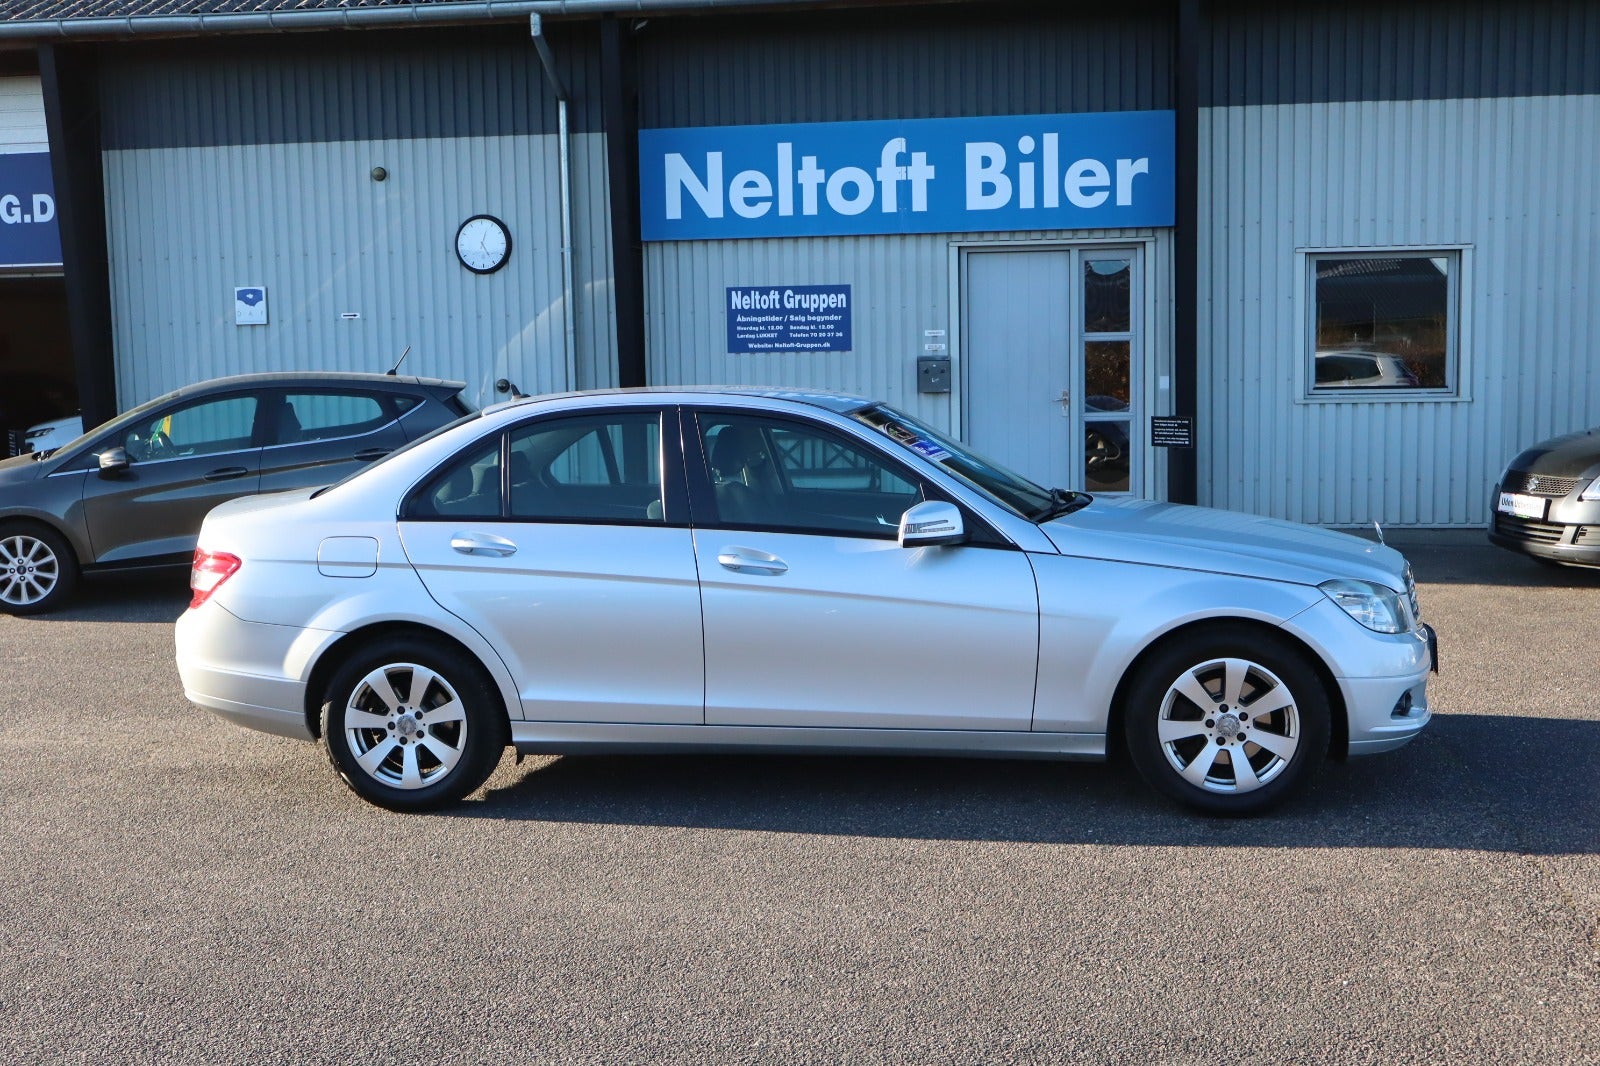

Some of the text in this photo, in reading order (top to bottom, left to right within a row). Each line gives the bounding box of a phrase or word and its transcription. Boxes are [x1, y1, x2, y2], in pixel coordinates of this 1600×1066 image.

[664, 132, 1149, 219] Neltoft Biler
[731, 289, 847, 312] Neltoft Gruppen
[736, 314, 783, 322] Åbningstider
[789, 314, 806, 322] Salg
[807, 314, 842, 322] begynder
[1501, 497, 1514, 507] Uden
